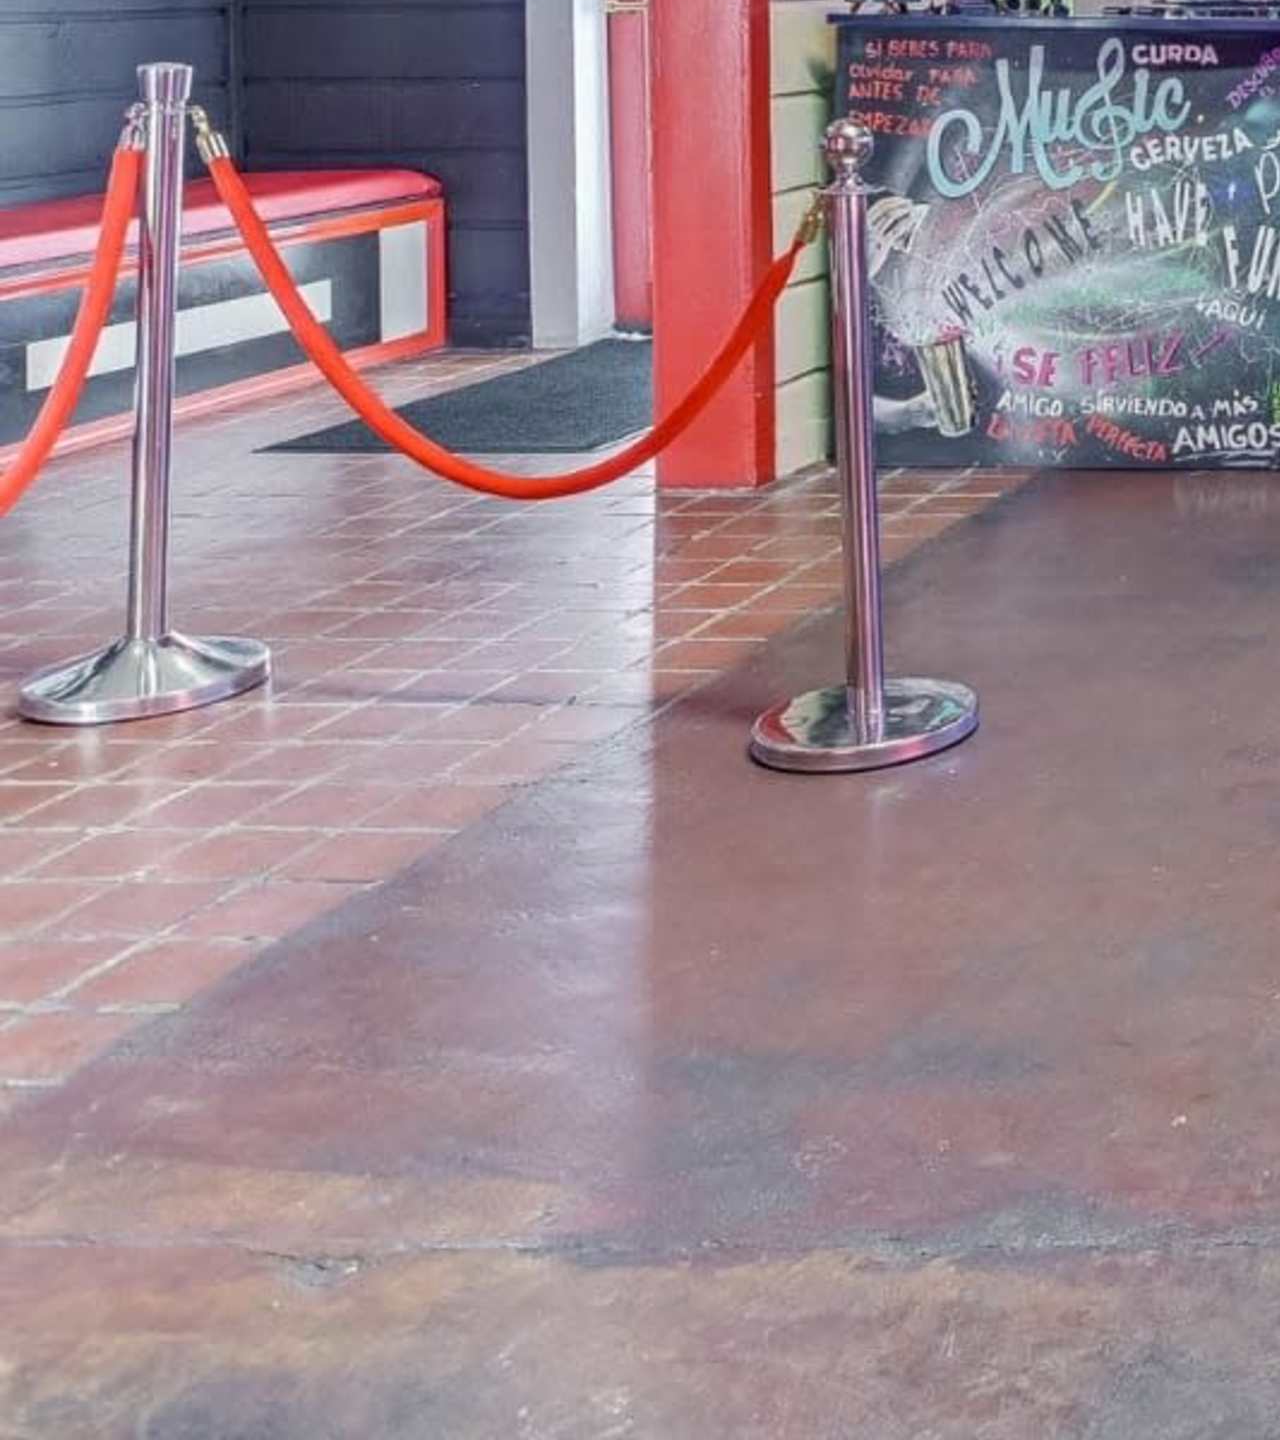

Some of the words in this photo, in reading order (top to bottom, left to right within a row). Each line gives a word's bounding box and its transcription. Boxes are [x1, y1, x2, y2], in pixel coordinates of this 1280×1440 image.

[1131, 43, 1220, 66] CURDA
[848, 80, 904, 101] ANTES
[926, 36, 1191, 199] Music
[1130, 128, 1255, 171] CERVEZA
[1124, 181, 1210, 248] HAVE
[1011, 345, 1062, 388] SE
[995, 389, 1065, 417] AMIGO
